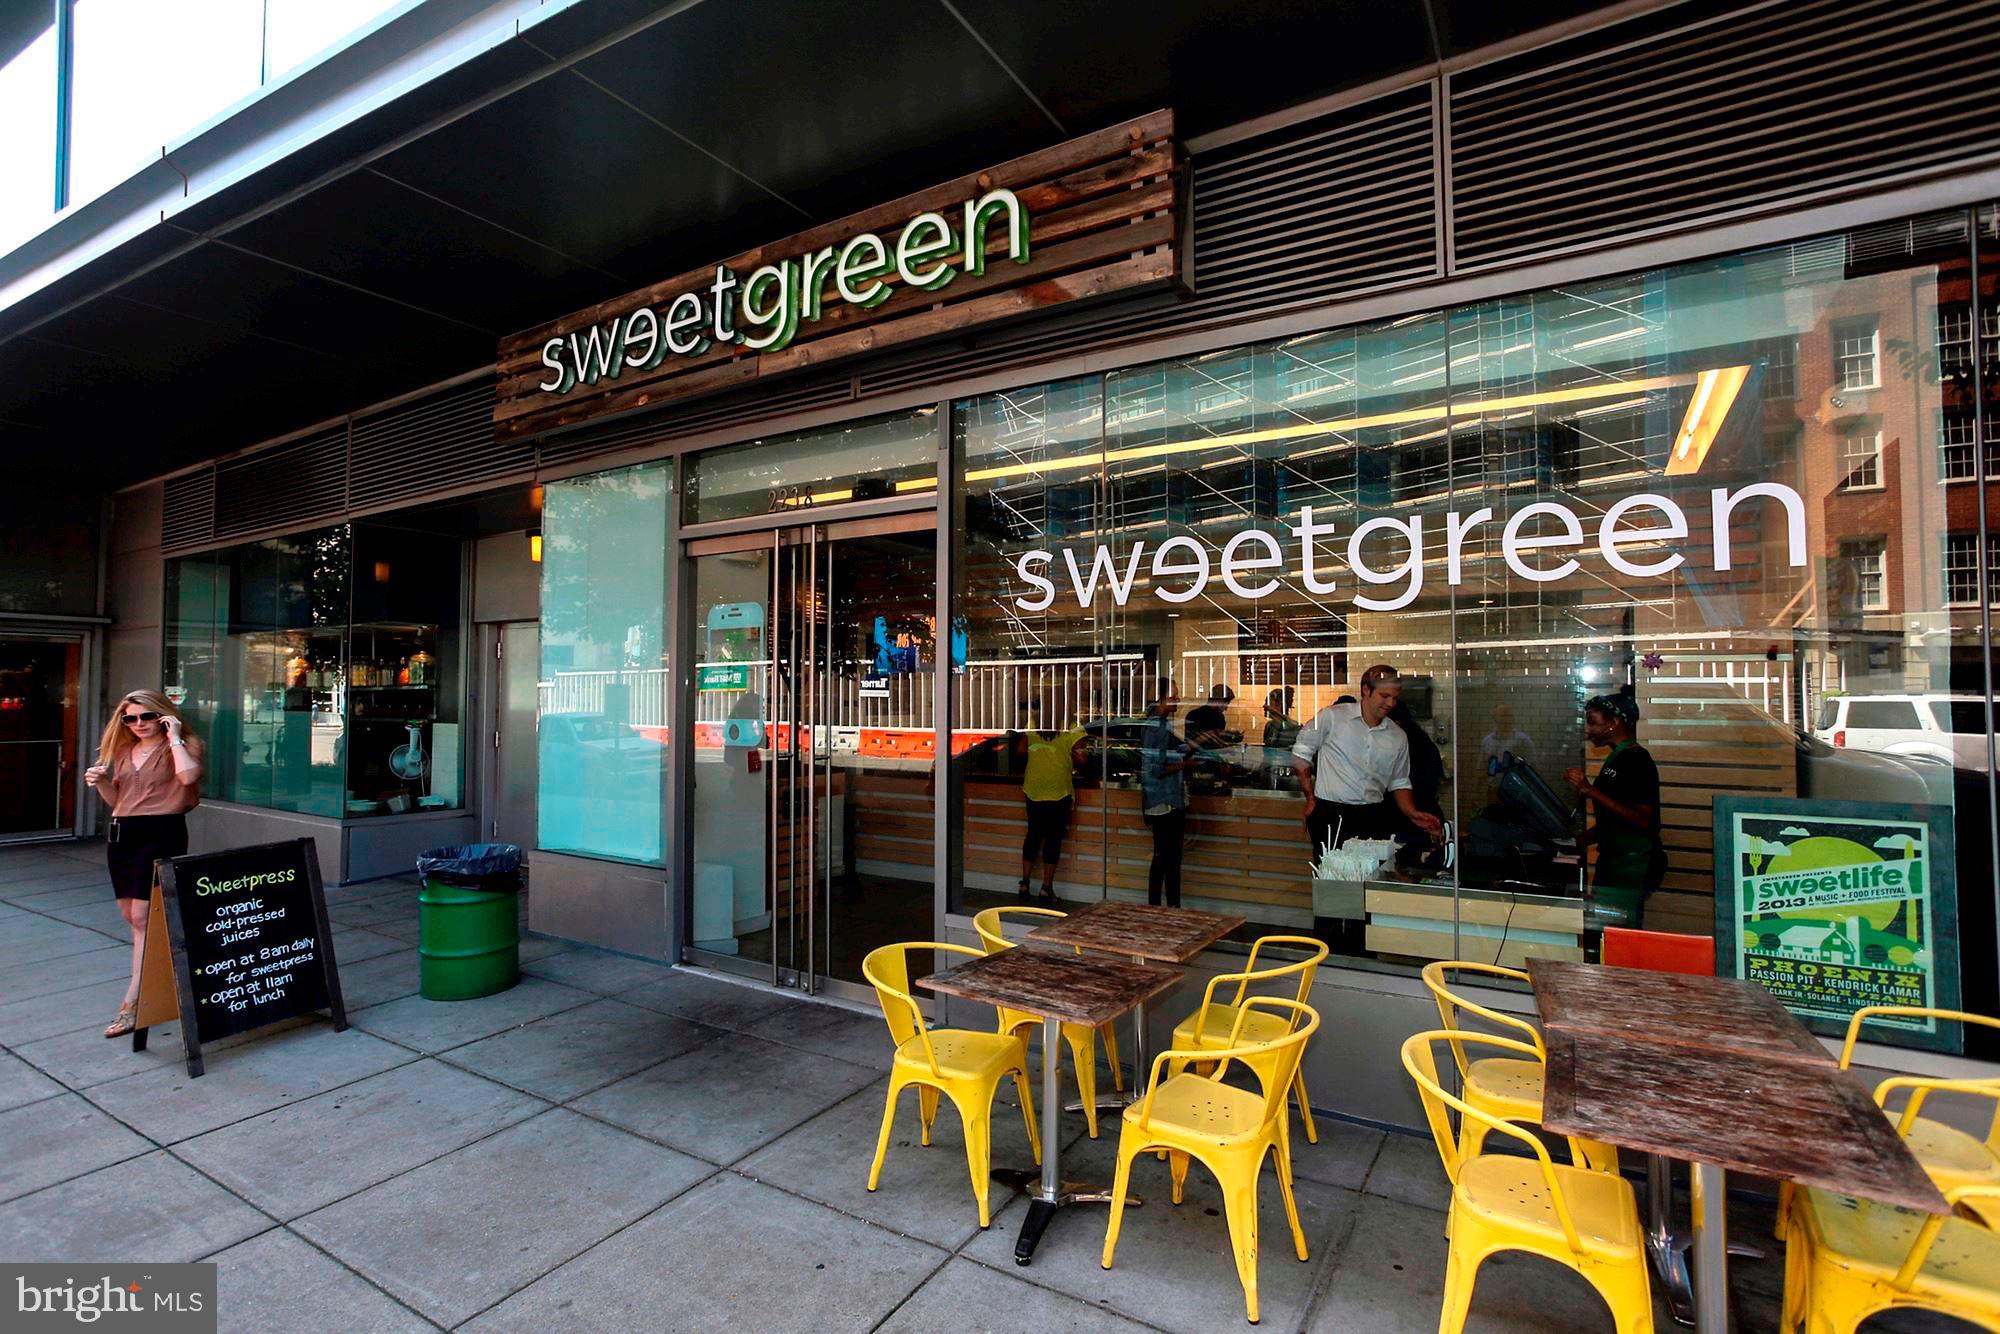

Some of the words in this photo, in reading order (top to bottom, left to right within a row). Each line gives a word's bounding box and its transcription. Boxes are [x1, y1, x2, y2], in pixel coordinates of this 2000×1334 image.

[540, 188, 1027, 393] sweetgreen
[1014, 482, 1807, 611] sweetgreen
[196, 868, 295, 896] Sweetpress
[1758, 865, 1903, 898] sweetlife
[1815, 893, 1838, 902] MUSIC
[1849, 890, 1869, 898] FOOD
[1871, 886, 1906, 896] FESTIVAL
[216, 898, 264, 917] organic
[1758, 897, 1806, 910] 2013
[205, 908, 286, 933] cold-pressed
[220, 927, 260, 946] juices
[205, 958, 236, 977] open
[240, 953, 255, 967] at
[260, 944, 290, 960] 8am
[291, 937, 315, 955] daily
[225, 971, 246, 984] for
[251, 951, 314, 977] sweetpress
[1750, 958, 1920, 988] PHOENIX
[1750, 969, 1794, 983] PASSION
[1797, 975, 1814, 985] PIT
[1825, 978, 1879, 993] KENDRICK
[1882, 984, 1920, 998] LAMAR
[1750, 978, 1796, 990] EAH
[210, 985, 244, 1004] open
[246, 980, 261, 993] at
[266, 972, 293, 988] 11am
[228, 1000, 248, 1013] for
[253, 988, 285, 1005] lunch
[1770, 988, 1793, 997] CLARK
[1807, 993, 1842, 1003] SOLANGE
